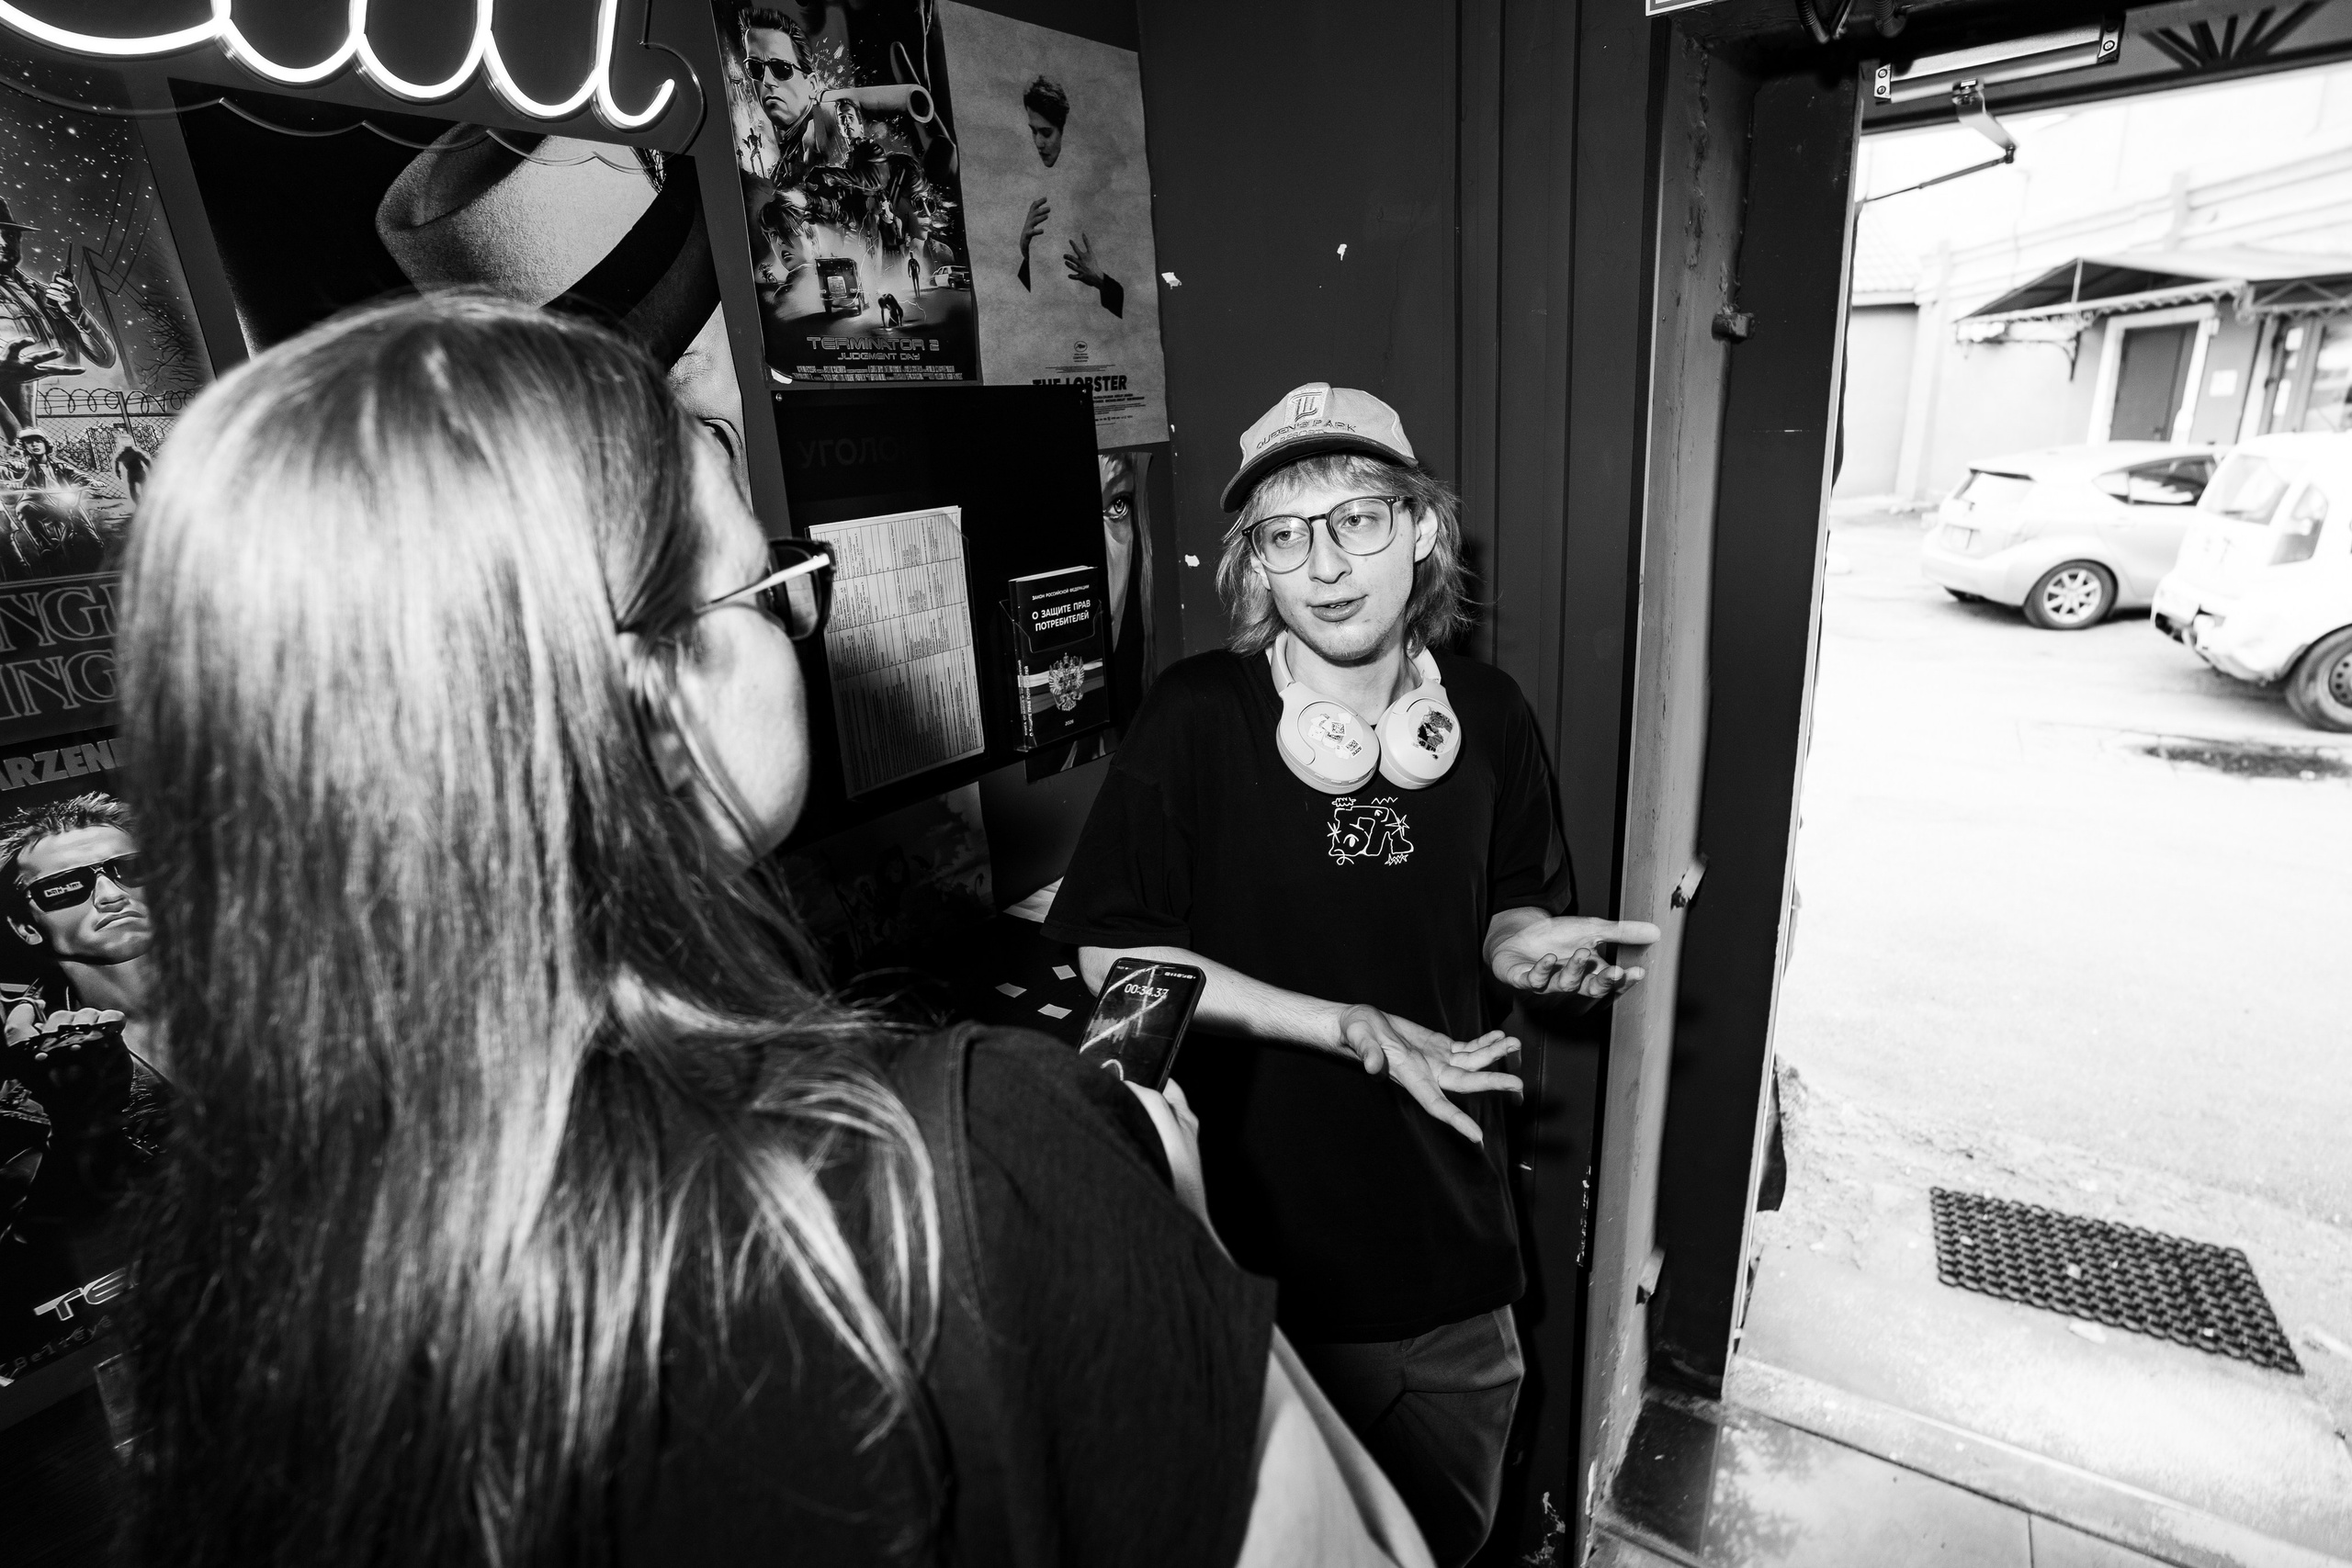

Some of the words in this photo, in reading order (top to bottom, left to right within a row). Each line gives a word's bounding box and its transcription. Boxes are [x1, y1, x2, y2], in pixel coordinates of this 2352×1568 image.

[806, 336, 925, 351] TERMINATOR
[929, 339, 940, 351] 2
[837, 352, 897, 360] JUDGMENT
[1256, 420, 1309, 449] QUEEN'S
[1312, 420, 1357, 433] PARK
[796, 436, 908, 469] УГОЛО
[1046, 588, 1069, 597] РОССИЙСКОЙ
[1032, 611, 1039, 620] О
[1041, 604, 1071, 619] ЗАЩИТЕ
[1073, 599, 1091, 611] ПРАВ
[1035, 609, 1090, 632] ПОТРЕБИТЕЛЕЙ
